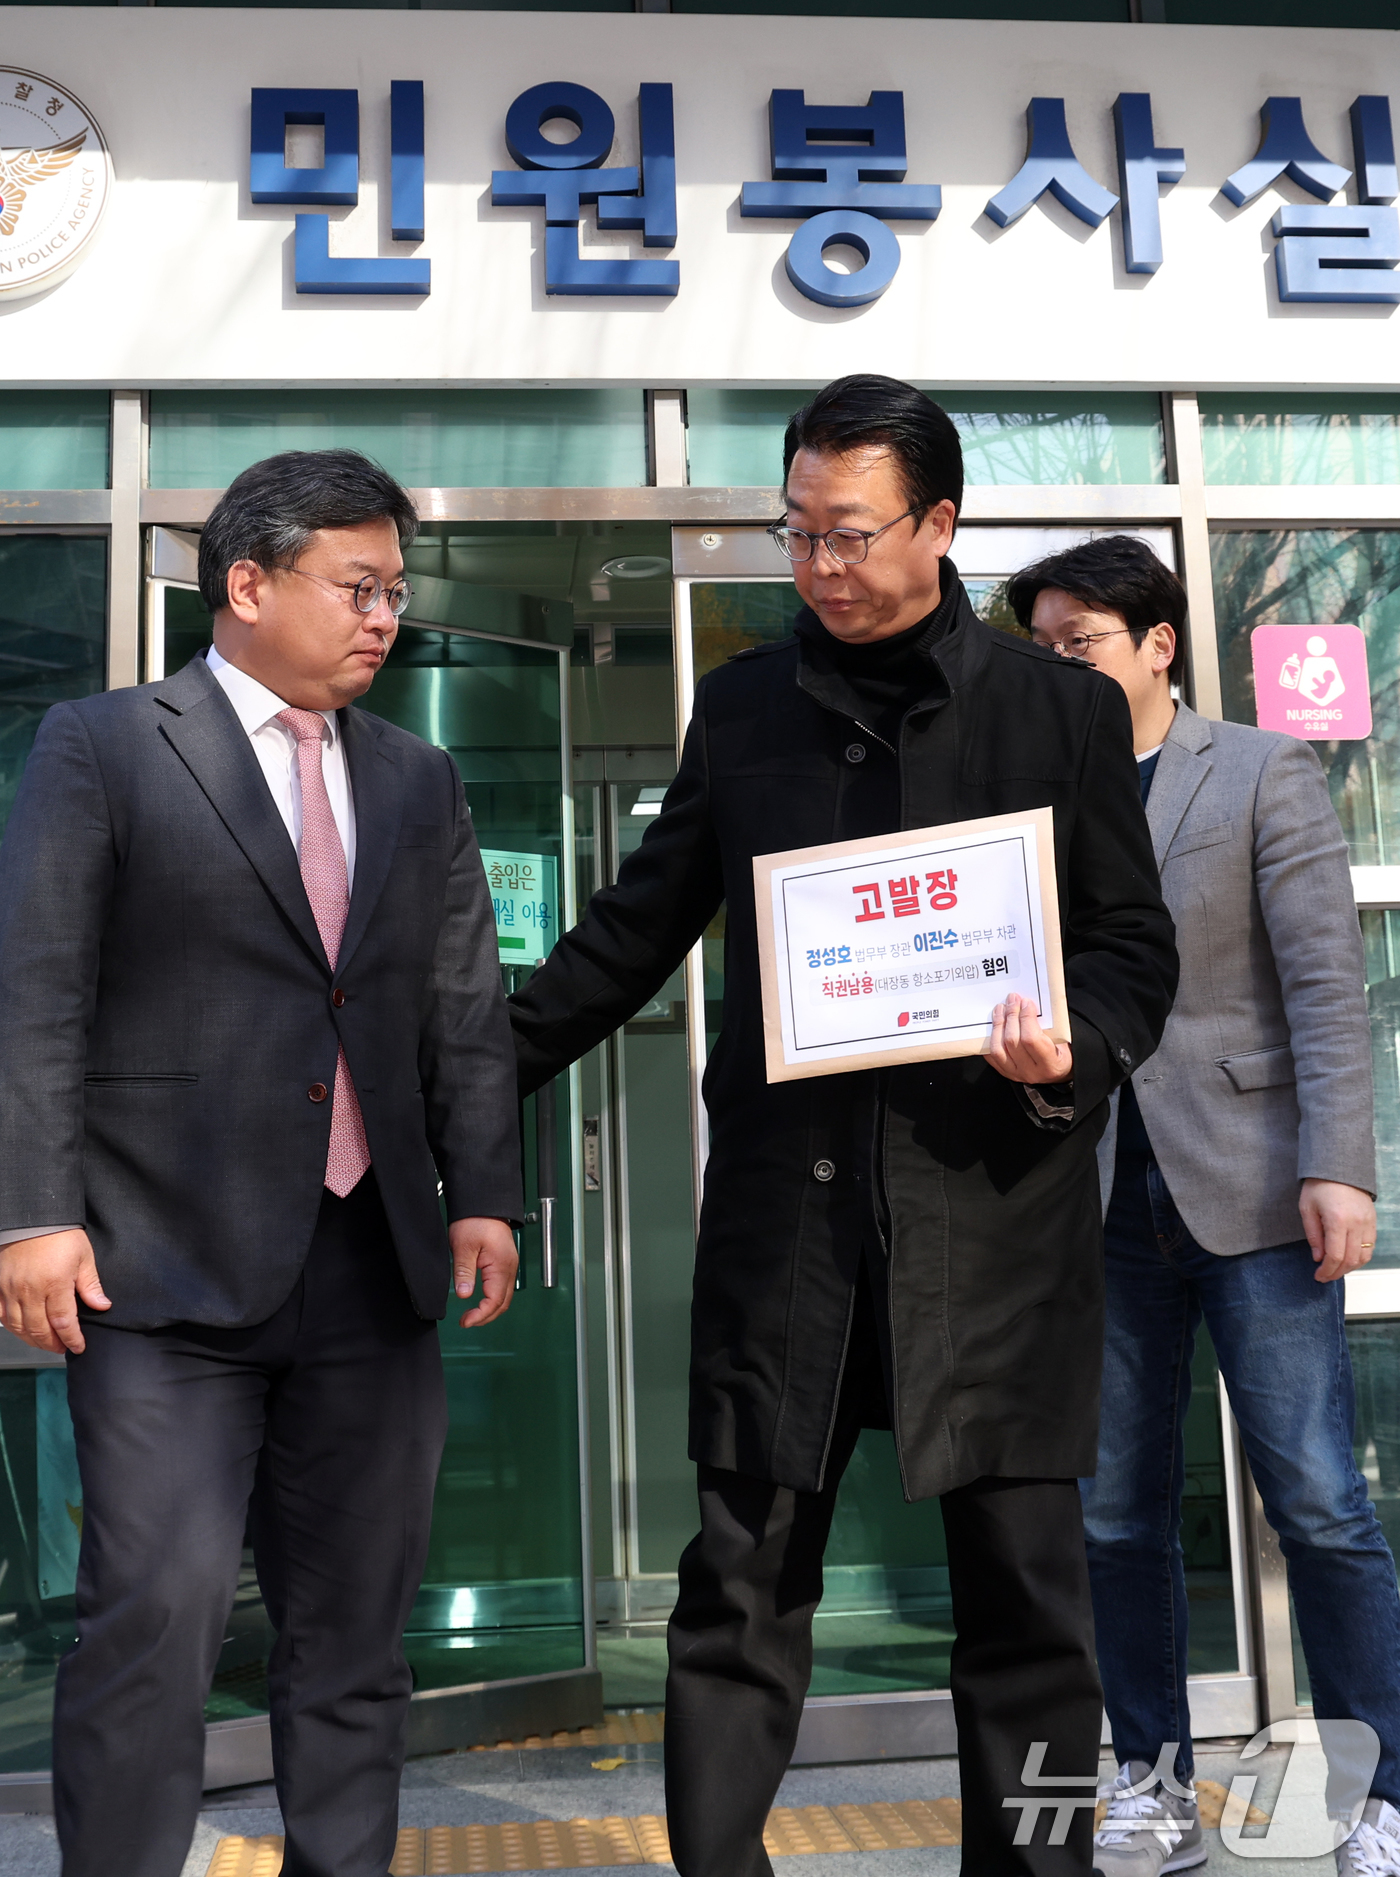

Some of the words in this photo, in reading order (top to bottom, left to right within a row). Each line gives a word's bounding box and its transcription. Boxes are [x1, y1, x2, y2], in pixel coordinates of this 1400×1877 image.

[250, 79, 1400, 308] 민원봉사실
[17, 230, 70, 269] POLICE
[68, 167, 95, 231] AGENCY
[1286, 709, 1343, 721] NURSING
[1304, 722, 1329, 731] 수유실
[488, 861, 536, 891] 출입은
[852, 868, 958, 923] 고발장
[522, 901, 552, 929] 이용
[806, 945, 852, 968] 정성호
[855, 946, 887, 963] 법무부
[890, 941, 911, 958] 장관
[914, 929, 959, 952] 이진수
[961, 928, 993, 947] 법무부
[996, 923, 1016, 941] 차관
[912, 965, 979, 987] 항소포기외압)
[982, 956, 1008, 977] 혐의
